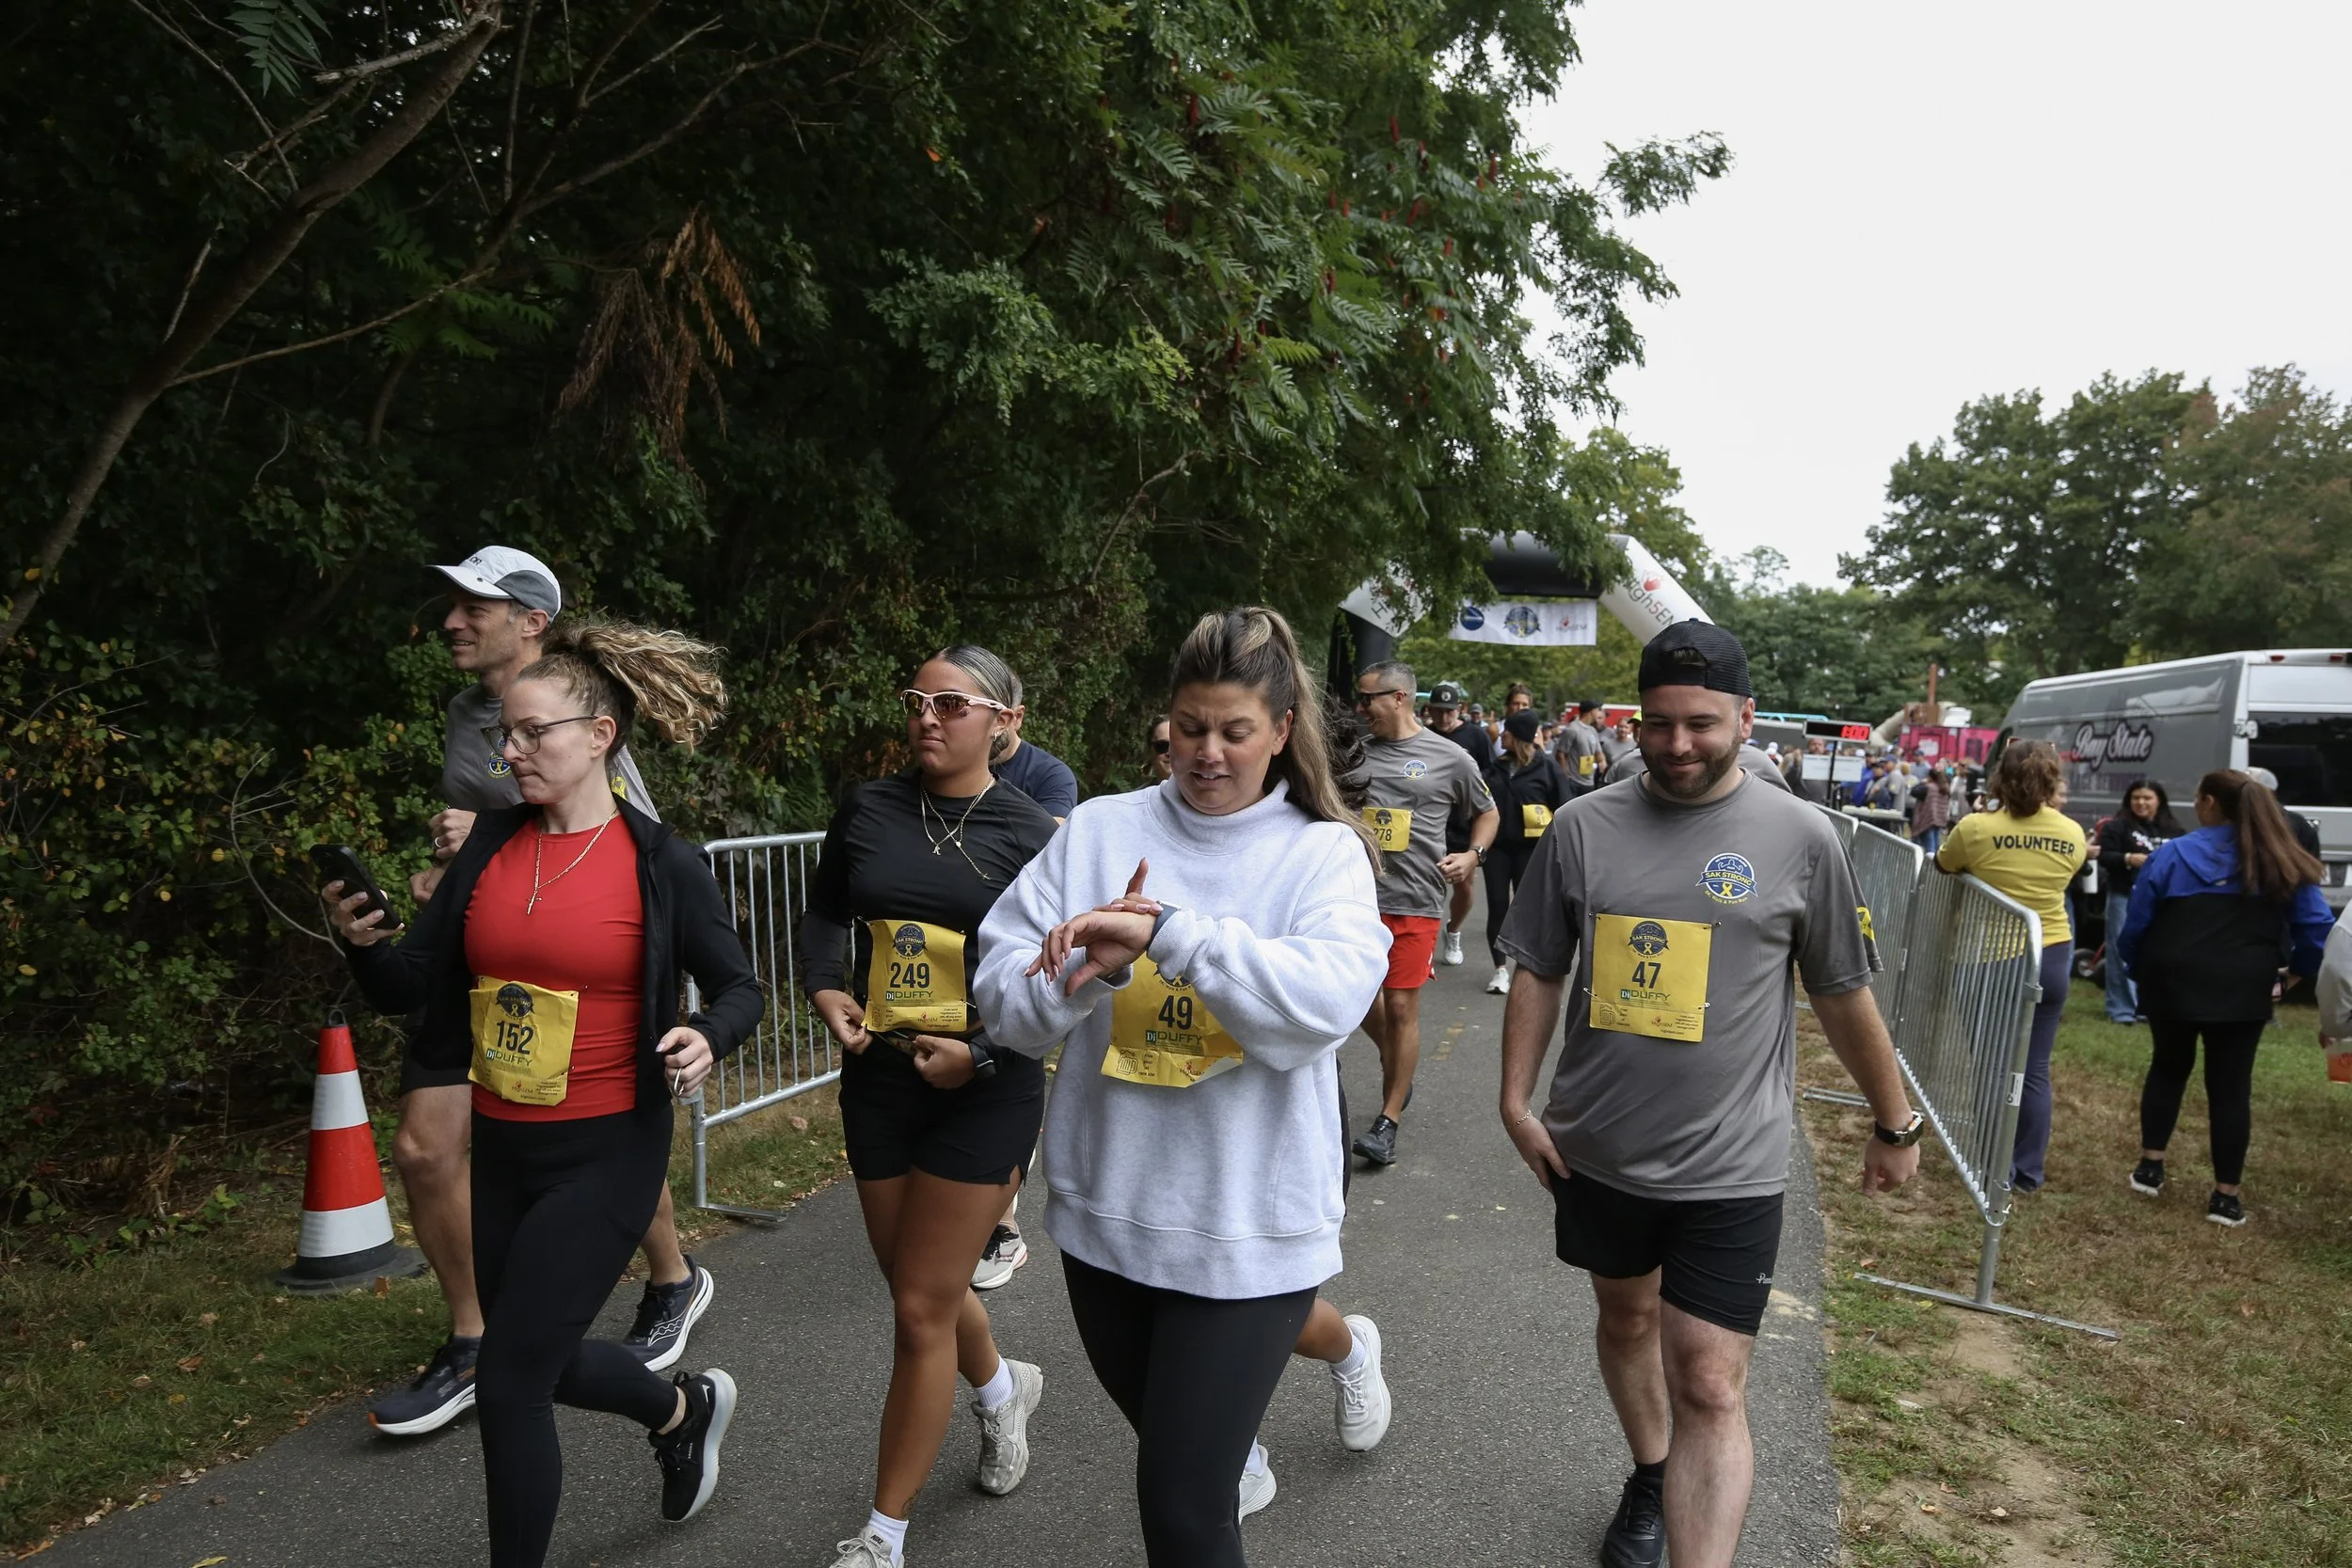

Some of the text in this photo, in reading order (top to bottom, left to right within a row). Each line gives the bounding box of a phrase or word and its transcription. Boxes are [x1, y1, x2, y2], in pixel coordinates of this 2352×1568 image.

[2072, 721, 2152, 768] Bay State
[1993, 835, 2074, 856] VOLUNTEER
[1722, 871, 1752, 886] STRONG
[1644, 935, 1665, 943] STRONG
[890, 962, 930, 988] 249
[1631, 961, 1661, 989] 47
[886, 990, 933, 1000] Di DUFFY
[1630, 990, 1671, 1001] DUFFY
[1158, 995, 1193, 1030] 49
[497, 1021, 533, 1054] 152
[1146, 1031, 1202, 1044] Di DUFFY
[495, 1051, 532, 1067] DUFFY
